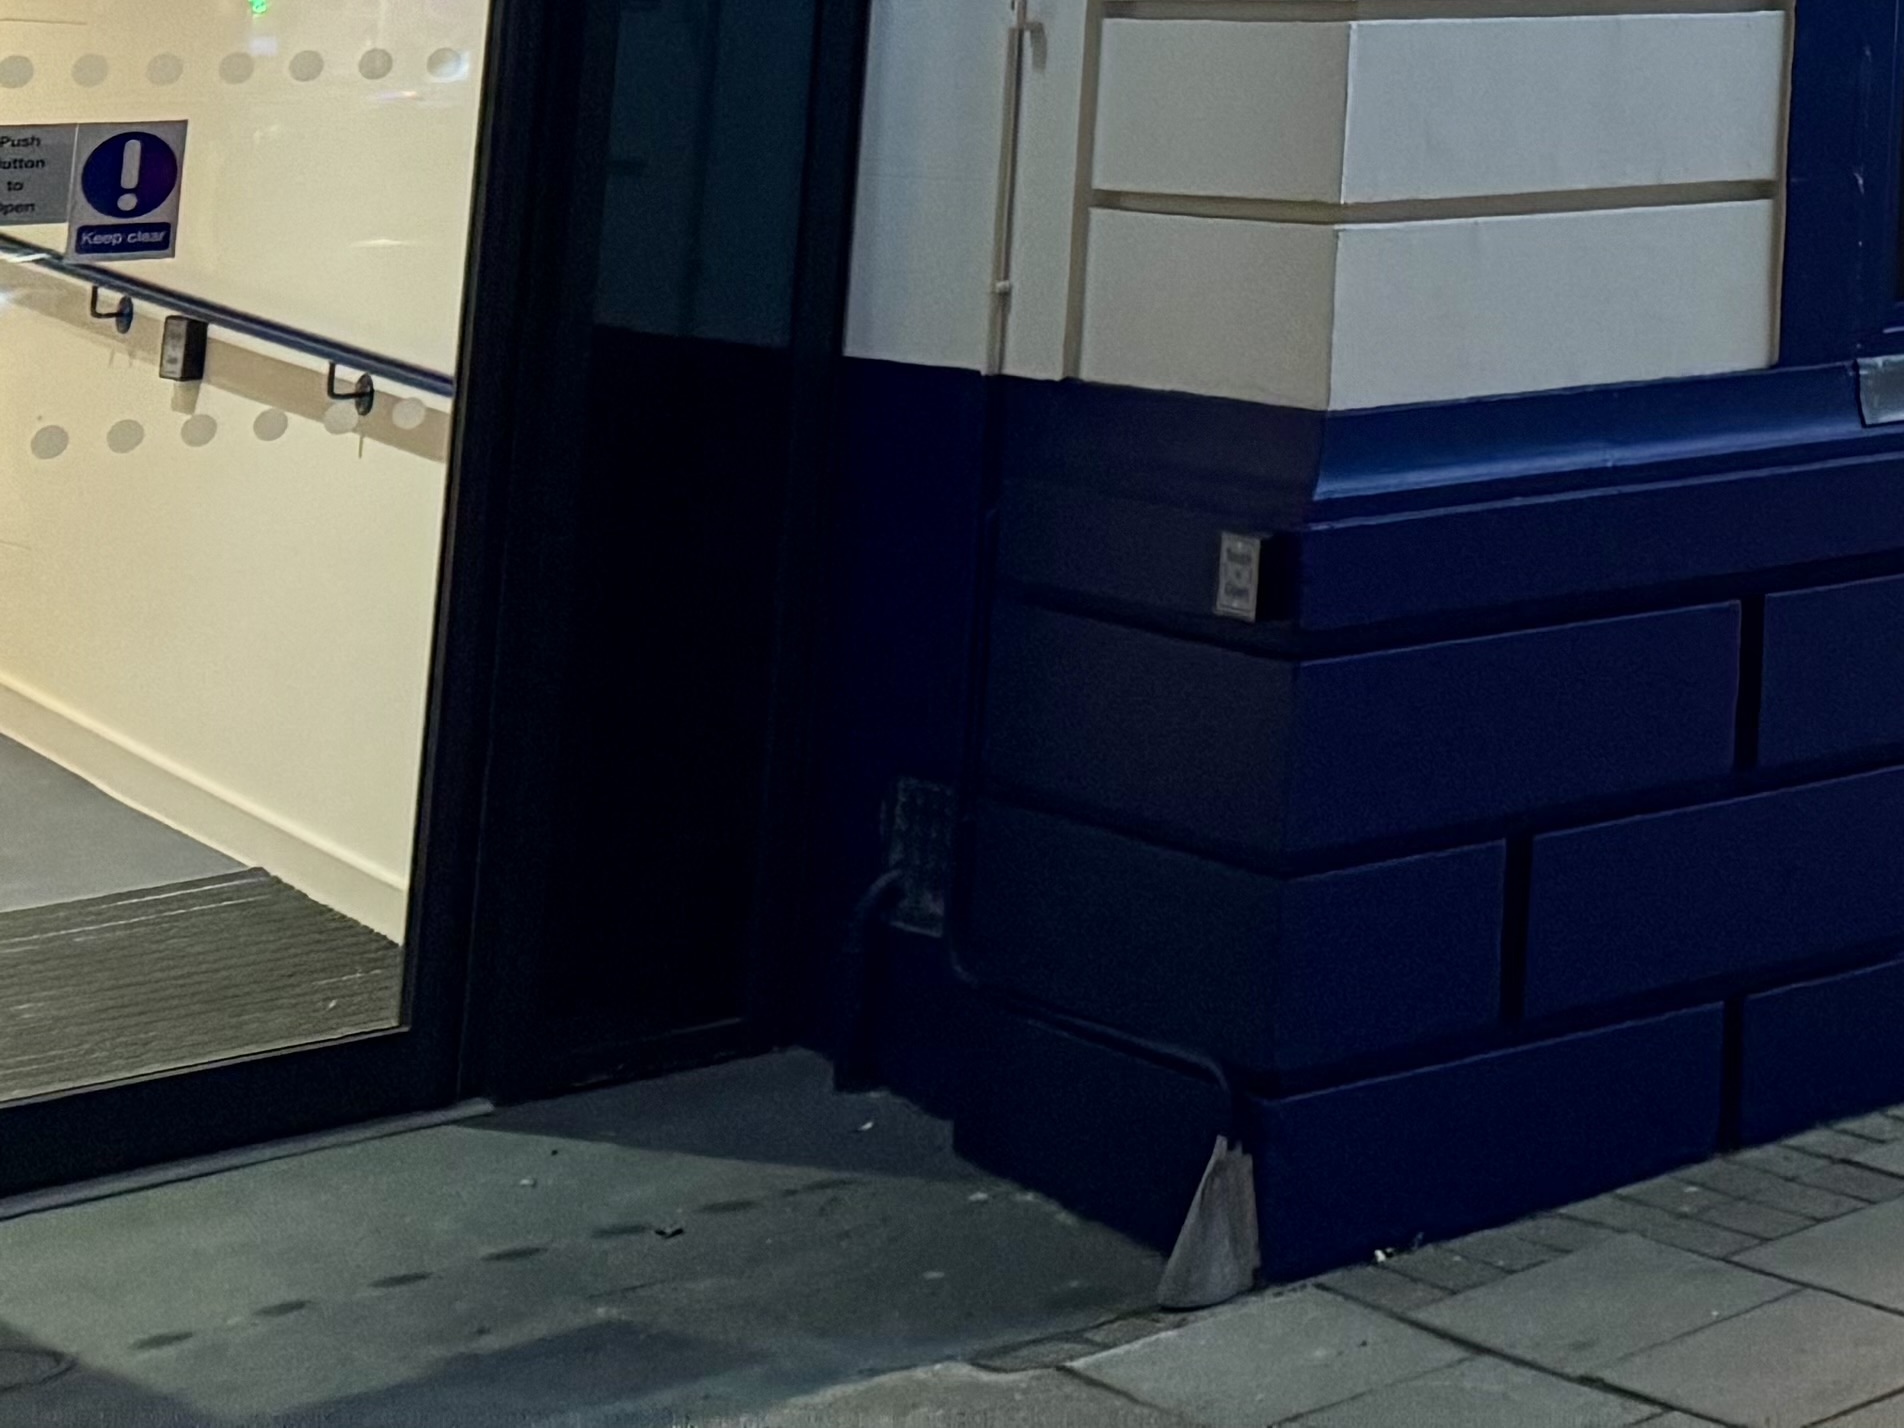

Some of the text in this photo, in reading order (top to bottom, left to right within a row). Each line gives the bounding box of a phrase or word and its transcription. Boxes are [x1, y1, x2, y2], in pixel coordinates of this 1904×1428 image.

[0, 158, 46, 170] utton
[7, 180, 24, 192] to
[81, 230, 167, 247] Keep clear
